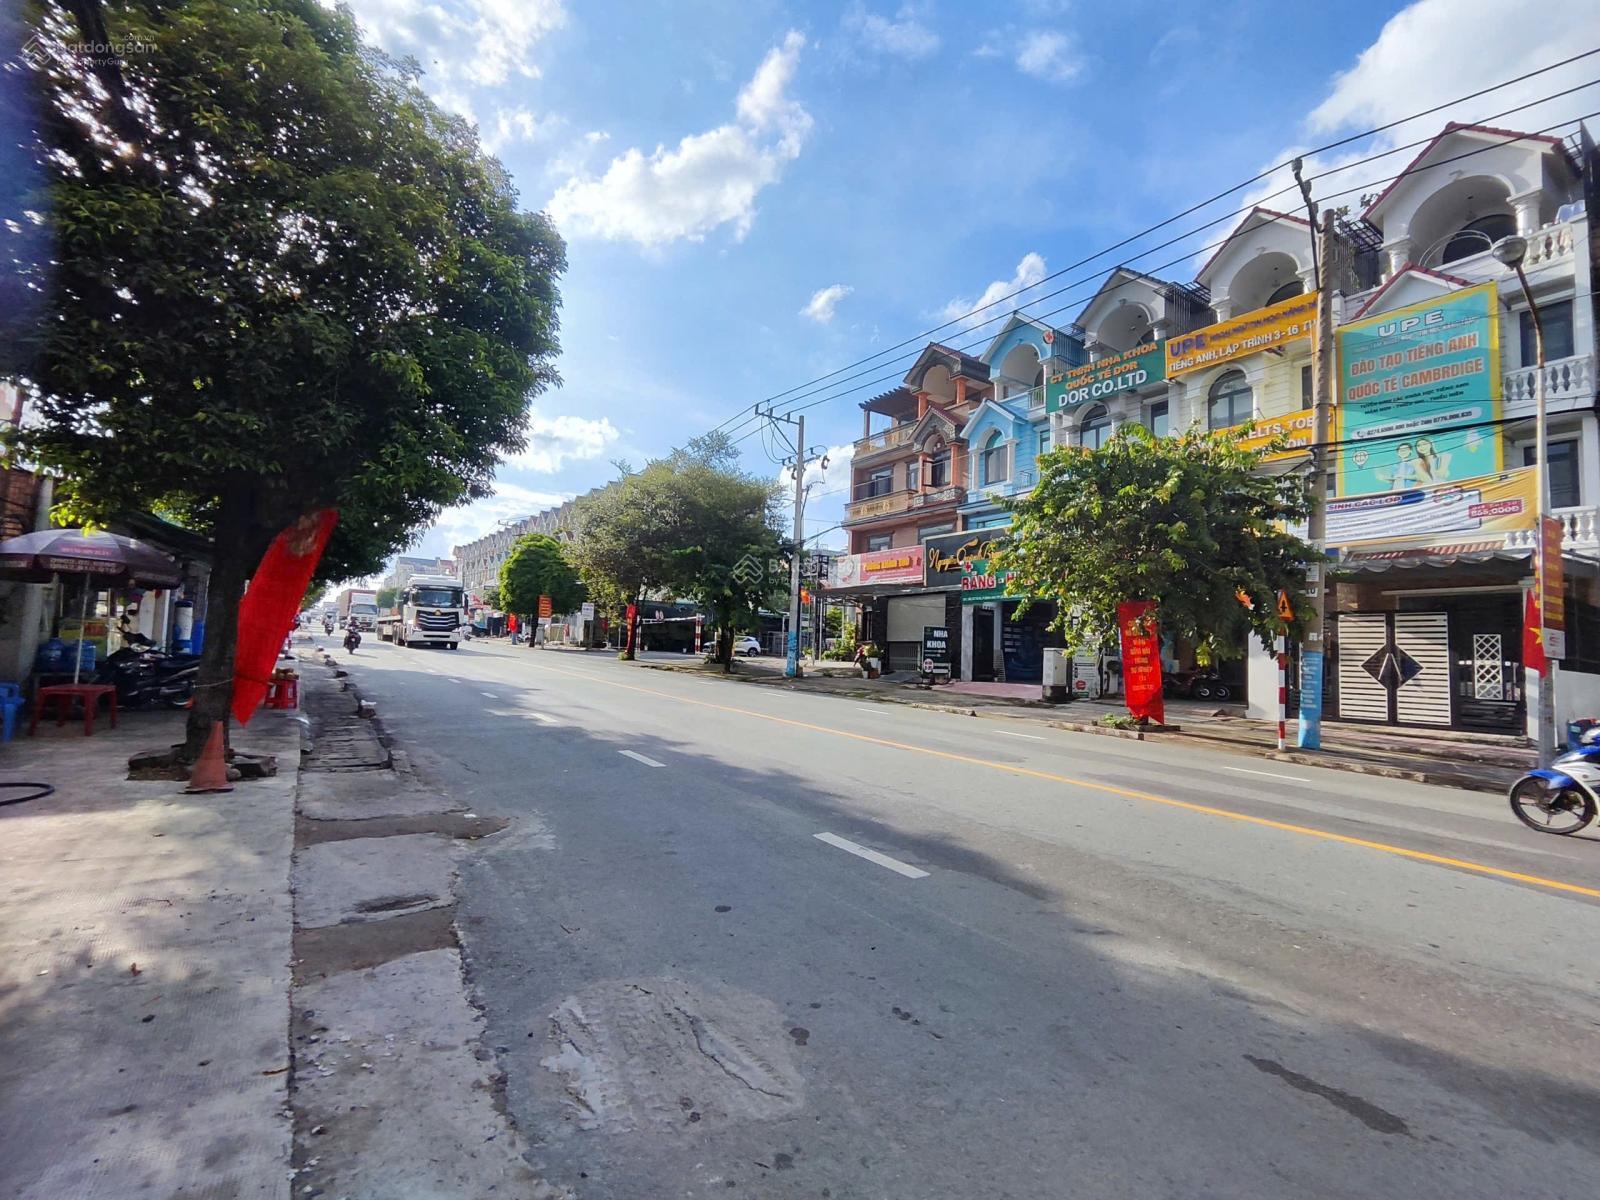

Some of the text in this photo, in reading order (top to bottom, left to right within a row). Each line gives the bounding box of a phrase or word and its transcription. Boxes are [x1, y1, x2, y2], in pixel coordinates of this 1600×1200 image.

[1242, 332, 1273, 349] TRÌNH
[1274, 331, 1281, 340] 3
[1288, 324, 1299, 336] 16
[1378, 310, 1444, 337] UPE
[1170, 333, 1206, 357] UPE
[1380, 352, 1403, 370] TẠO
[1406, 341, 1444, 362] TIẾNG
[1448, 333, 1478, 353] ANH
[1067, 363, 1095, 378] TNHH
[1097, 354, 1121, 369] NHA
[1123, 342, 1157, 360] KHOA
[1402, 358, 1483, 388] CAMBRDIGE
[1058, 369, 1148, 407] DOR CO.LTD
[1065, 361, 1138, 389] QUỐC TẾ DOR
[1247, 422, 1285, 439] ELTS,
[962, 571, 996, 590] RĂNG
[926, 640, 947, 649] KHOA
[933, 630, 949, 638] NHA
